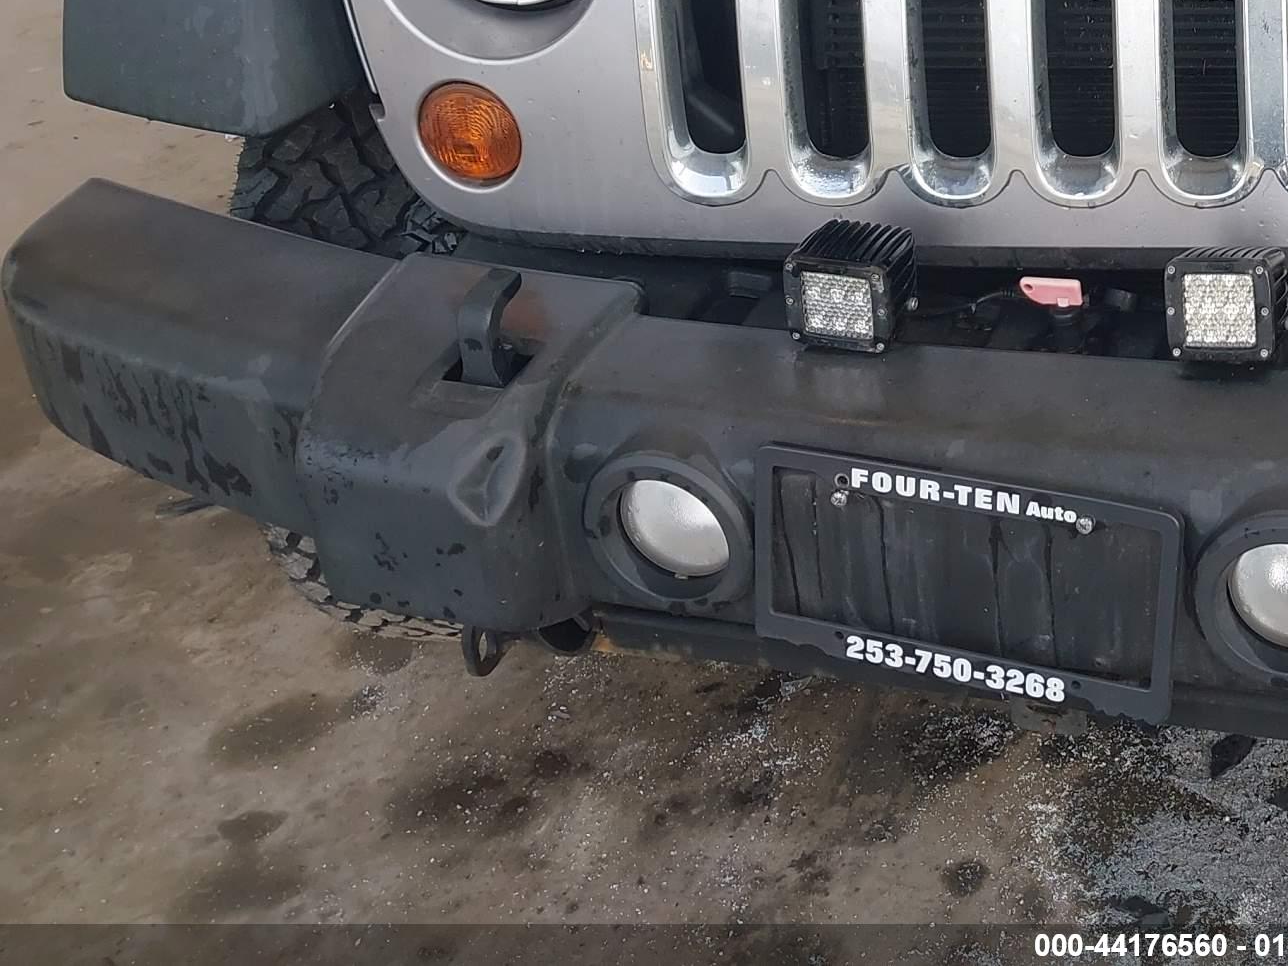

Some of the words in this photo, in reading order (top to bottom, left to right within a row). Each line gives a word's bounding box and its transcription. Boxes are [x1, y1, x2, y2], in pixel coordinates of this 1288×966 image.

[850, 467, 1021, 515] FOUR-TEN
[1025, 500, 1077, 524] Auto
[845, 635, 1066, 703] 253-750-3268
